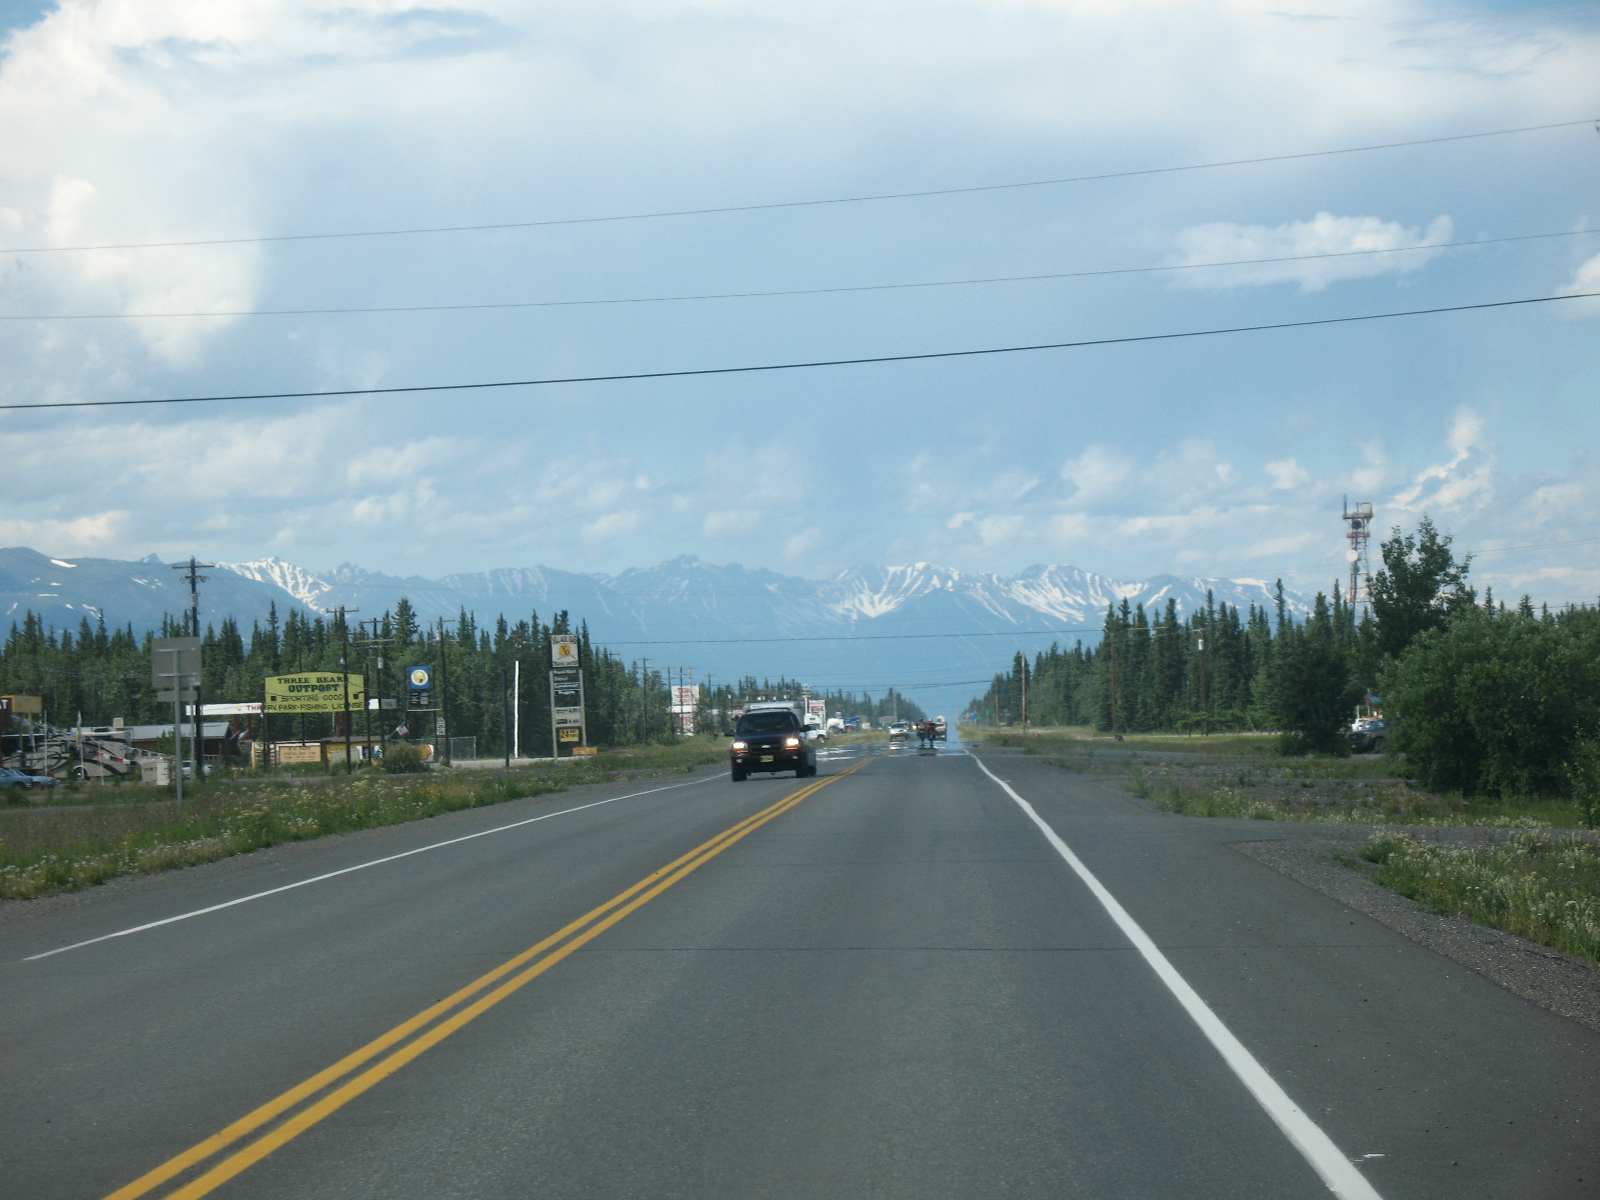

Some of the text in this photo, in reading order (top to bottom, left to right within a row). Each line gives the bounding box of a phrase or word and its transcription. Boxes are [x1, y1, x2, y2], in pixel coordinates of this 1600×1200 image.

[552, 635, 578, 645] VILLAGE GAS
[289, 684, 339, 692] OUTPOST
[332, 702, 364, 710] LICNSE
[561, 730, 569, 738] 24
